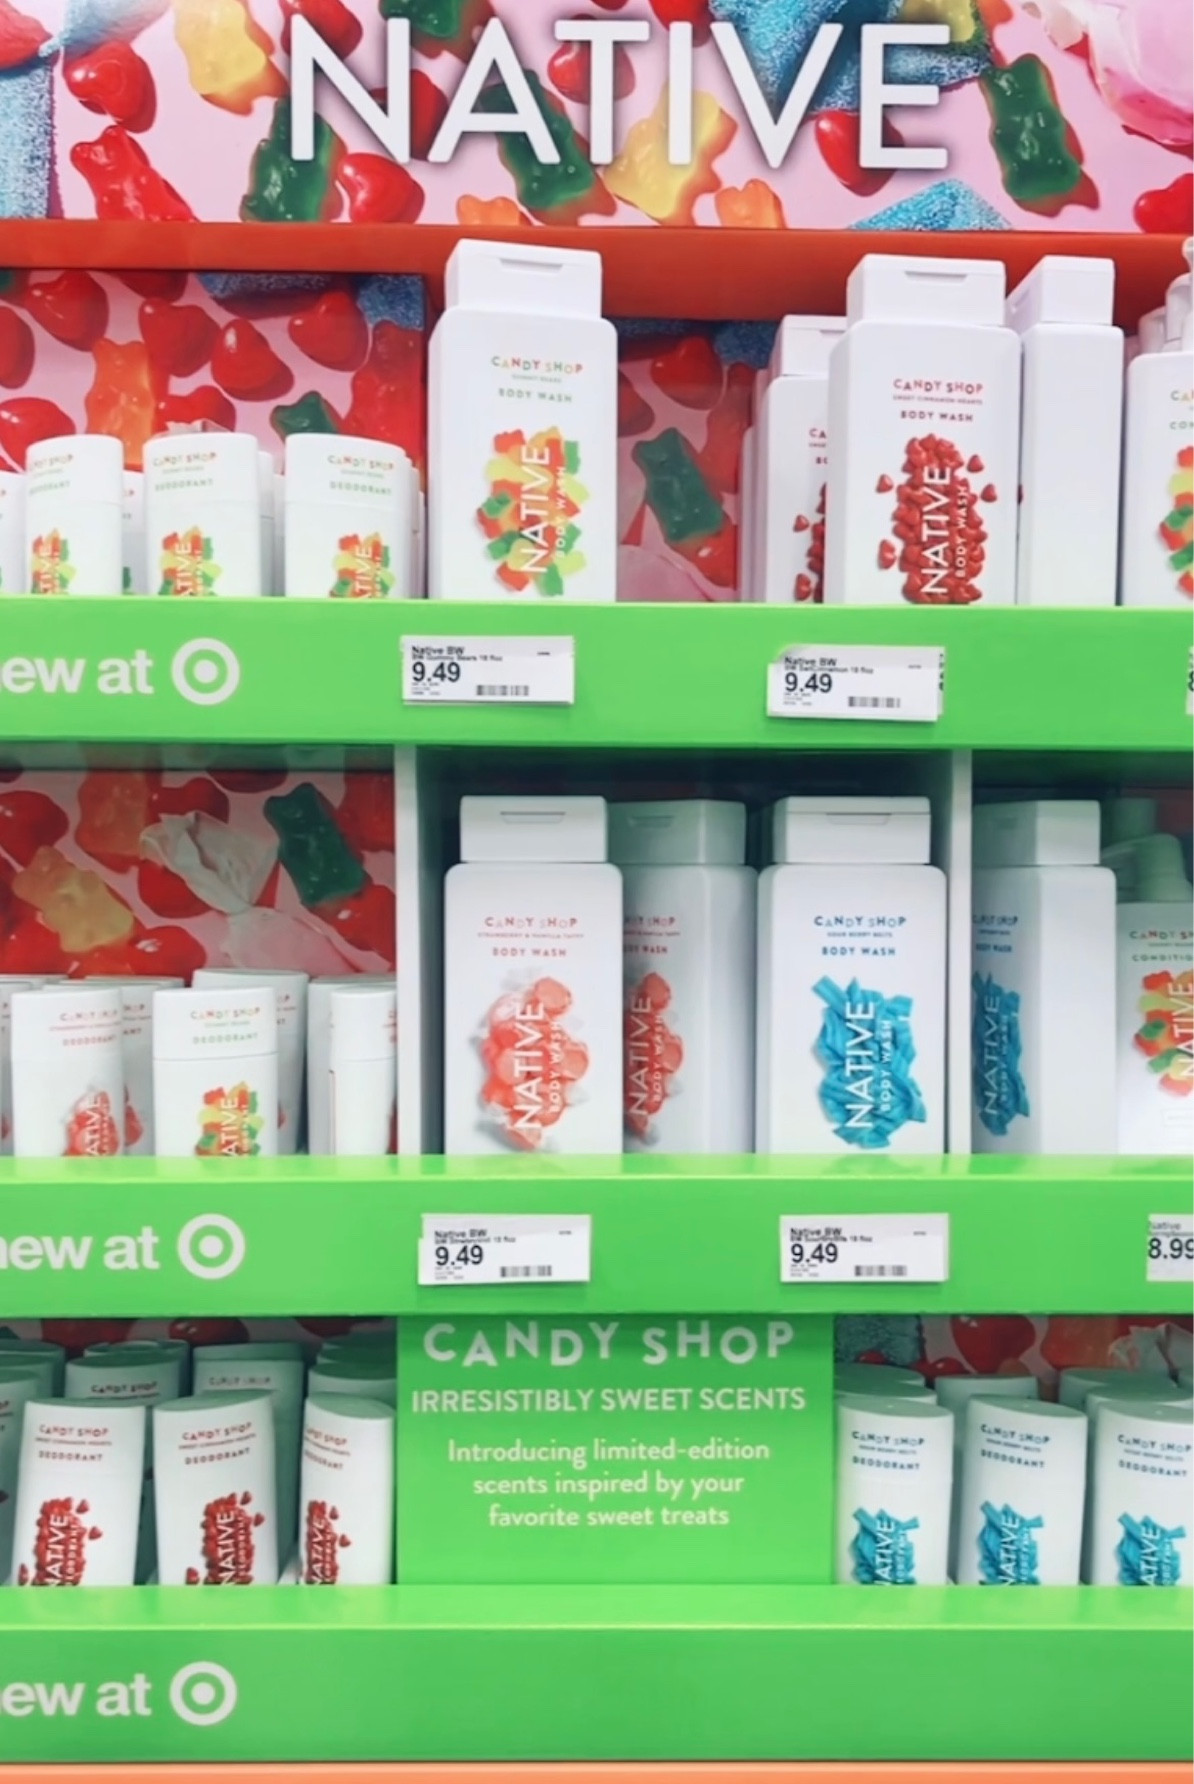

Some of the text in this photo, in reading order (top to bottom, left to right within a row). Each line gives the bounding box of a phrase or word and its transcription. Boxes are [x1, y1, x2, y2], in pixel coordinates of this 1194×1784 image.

[291, 16, 950, 169] NATIVE
[491, 356, 583, 374] CANDY SHOP
[499, 388, 572, 403] BODY WASH
[893, 379, 983, 395] CANDY SHOP
[900, 410, 973, 422] BODY WASH
[153, 452, 216, 467] CANDY SHOP
[327, 455, 394, 471] CANDY SHOP
[329, 481, 391, 495] DEODORANT
[520, 446, 550, 573] NATIVE
[921, 466, 951, 594] NATIVE
[954, 485, 970, 578] BODY WASH
[412, 646, 465, 655] Native BW
[0, 649, 154, 694] ew at
[412, 661, 461, 683] 9.49
[784, 657, 837, 667] Native BW
[785, 672, 833, 694] 9.49
[484, 917, 578, 929] CANDY SHOP
[814, 916, 906, 928] CANDY SHOP
[1129, 930, 1175, 941] CANDY
[493, 947, 567, 957] BODY WASH
[642, 946, 668, 954] WASH
[822, 947, 896, 956] BODY WASH
[190, 1007, 261, 1020] CANDY SHOP
[192, 1033, 258, 1044] DEODORANT
[629, 997, 651, 1115] NATIVE
[845, 1001, 874, 1129] NATIVE
[985, 995, 1000, 1115] NATIVE
[514, 1002, 544, 1130] NATIVE
[549, 1020, 563, 1113] BODY WASH
[880, 1020, 892, 1112] BODY WASH
[86, 1096, 101, 1156] ATIVE
[221, 1097, 239, 1156] ATIVE
[435, 1229, 487, 1239] Native BW
[790, 1227, 842, 1236] Native BW
[103, 1225, 161, 1270] at
[435, 1244, 483, 1266] 9.49
[791, 1242, 838, 1264] 9.49
[1148, 1237, 1194, 1259] 8.99
[423, 1320, 794, 1366] CANDY SHOP
[412, 1386, 806, 1412] IRRESISTIBLY SWEET SCENTS
[39, 1425, 109, 1438] CANDY SHOP
[182, 1422, 253, 1441] CANDY SHOP
[852, 1431, 925, 1446] CANDY SHOP
[981, 1424, 1050, 1445] CANDY SHOP
[448, 1437, 770, 1470] Introducing limited-edition
[1117, 1434, 1192, 1453] CANDY SHOP
[39, 1450, 103, 1462] DEODORANT
[185, 1447, 250, 1465] DEODORANT
[853, 1456, 920, 1470] DEODORANT
[981, 1449, 1045, 1469] DEODORANT
[1119, 1459, 1188, 1477] DEODORANT
[473, 1470, 745, 1502] scents inspired by your
[489, 1503, 730, 1527] favorite sweet treats
[875, 1518, 895, 1586] ATIVE
[1141, 1521, 1161, 1586] ATIVE
[0, 1673, 152, 1716] ew at
